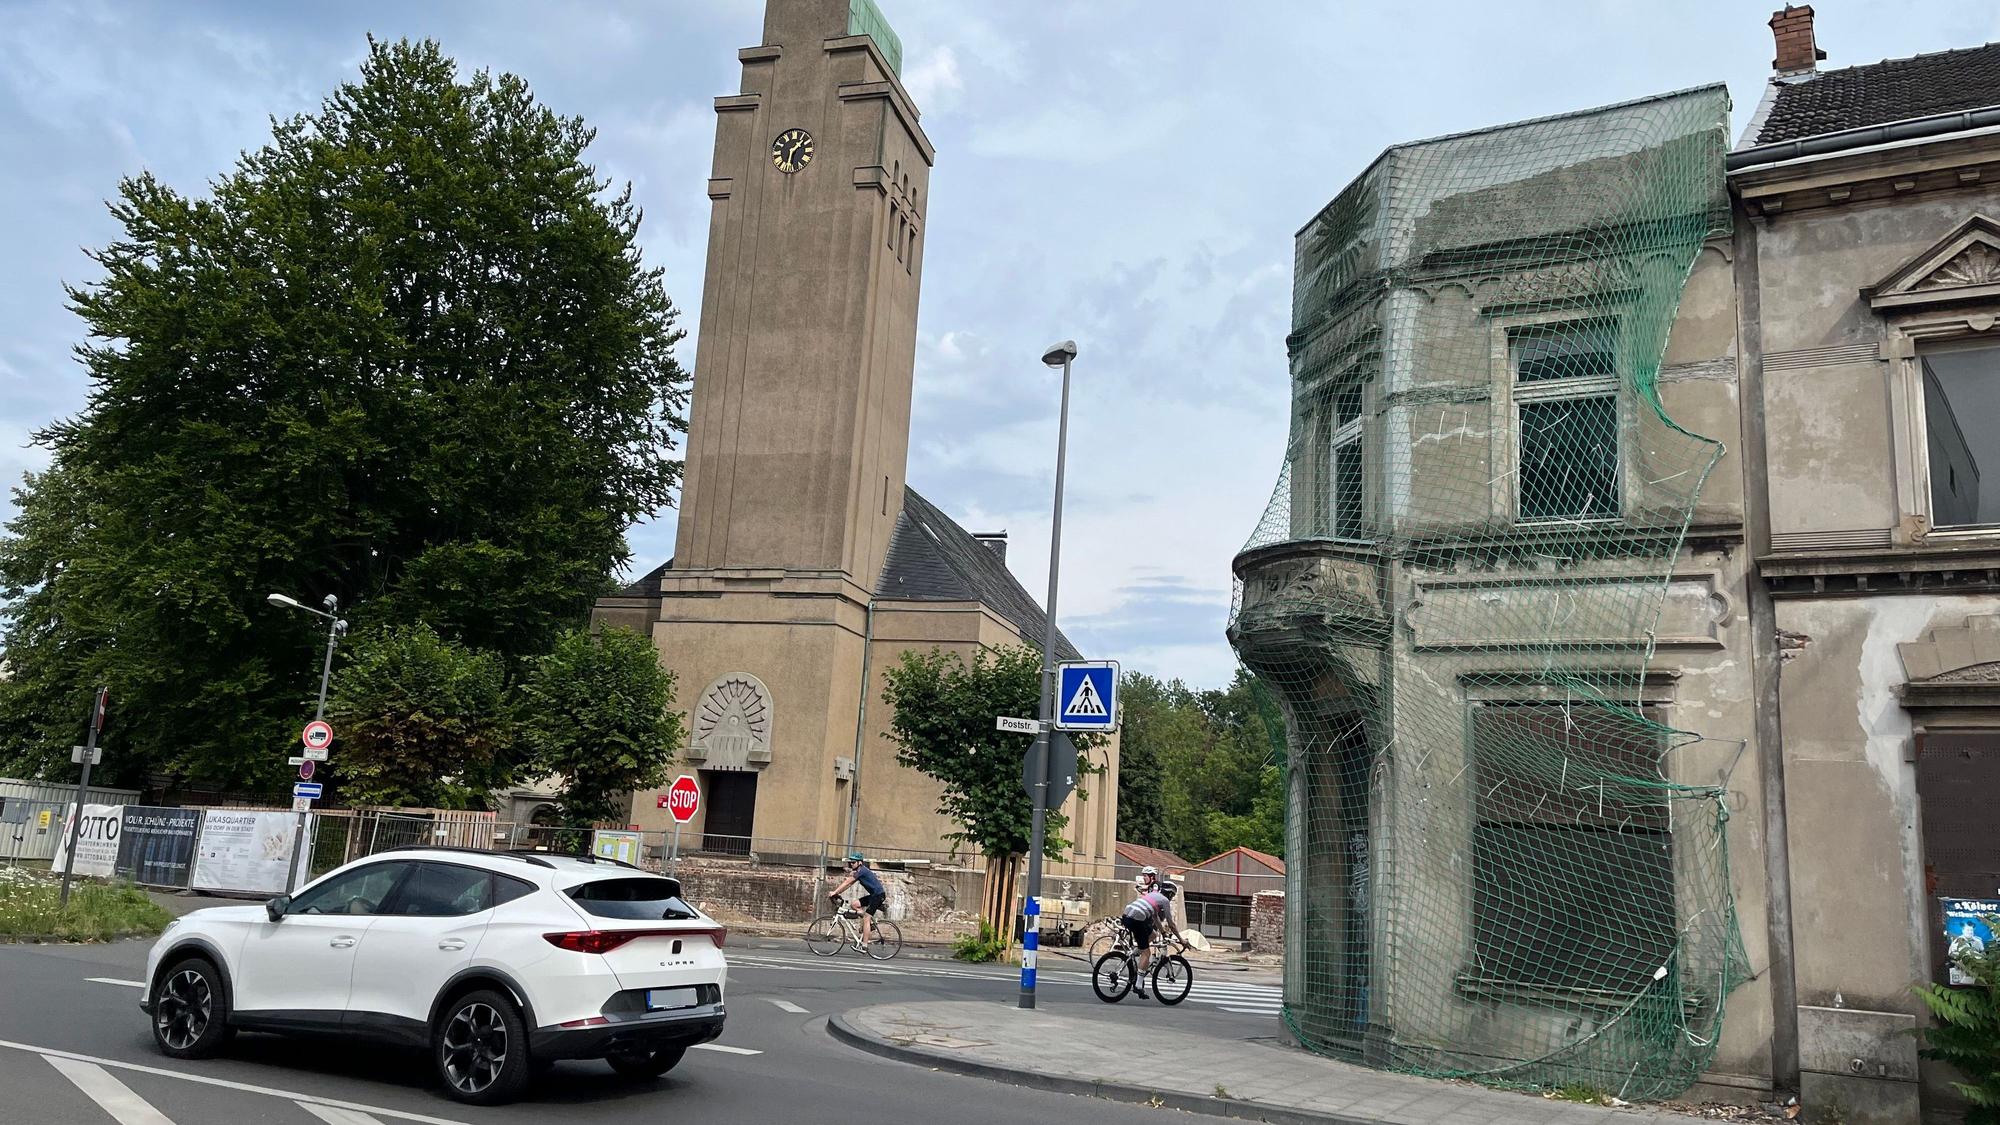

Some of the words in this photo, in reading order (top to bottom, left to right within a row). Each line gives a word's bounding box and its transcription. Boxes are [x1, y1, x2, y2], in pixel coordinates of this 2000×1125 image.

[1002, 719, 1033, 730] Poststr.
[671, 789, 697, 808] STOP
[168, 817, 195, 828] PROJEKTE
[205, 815, 256, 825] LUKASQUARTIER
[78, 815, 119, 840] OTTO
